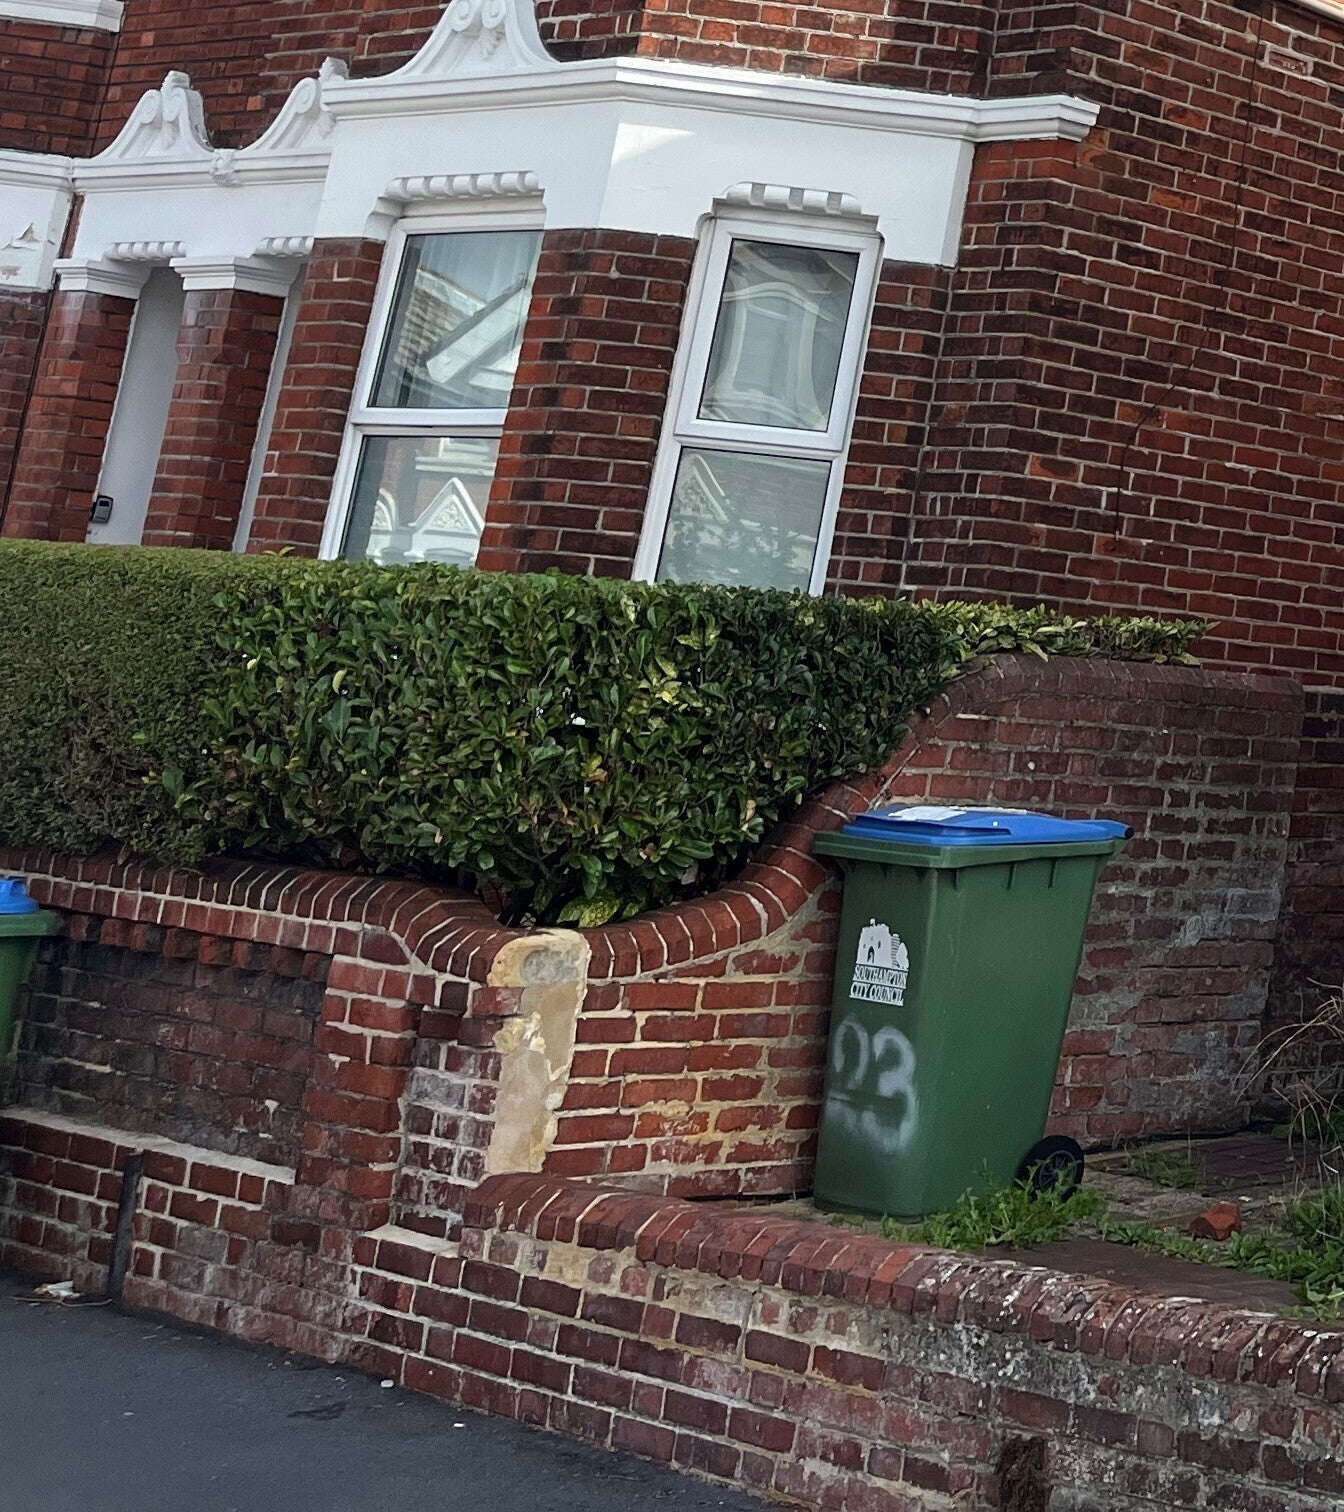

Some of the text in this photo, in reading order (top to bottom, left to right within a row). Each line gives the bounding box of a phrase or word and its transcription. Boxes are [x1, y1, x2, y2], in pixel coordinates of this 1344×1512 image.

[850, 982, 903, 1005] CITY COUNCIL
[826, 1012, 919, 1152] 23
